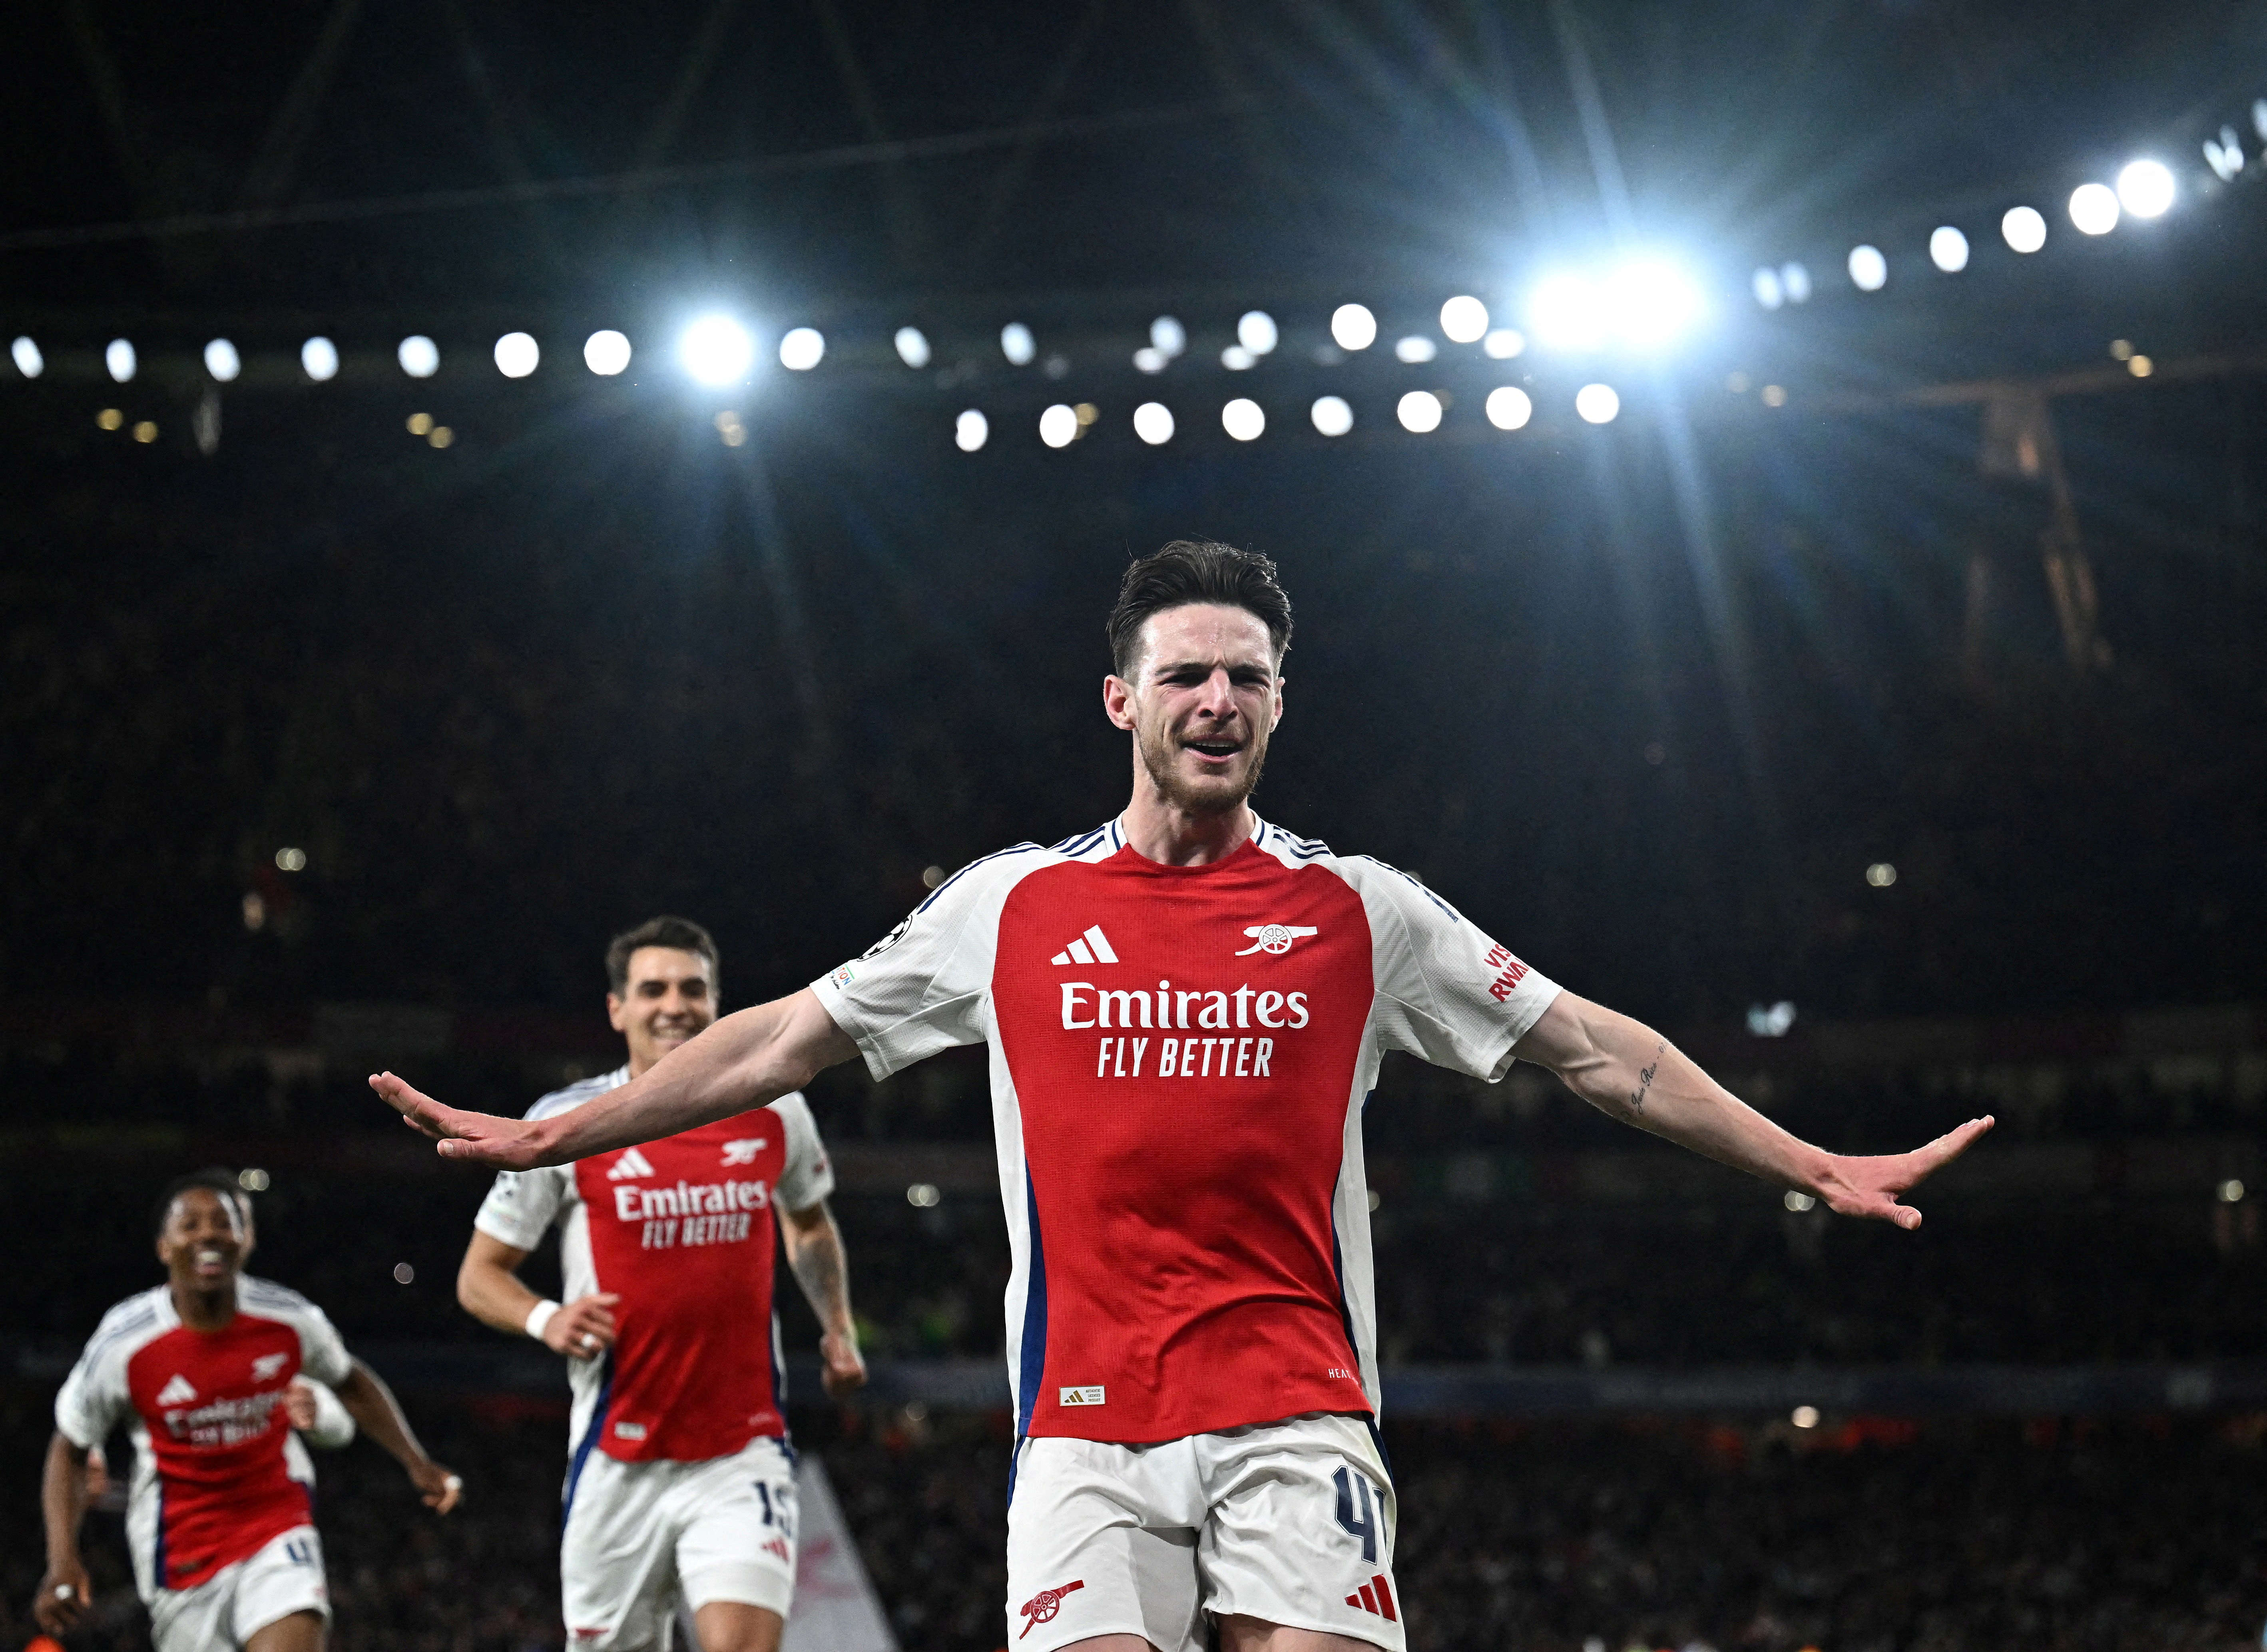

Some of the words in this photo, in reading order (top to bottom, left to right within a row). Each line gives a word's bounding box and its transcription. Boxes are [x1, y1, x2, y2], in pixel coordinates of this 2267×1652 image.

[1488, 957, 1530, 1002] RWA
[1060, 980, 1309, 1030] Emirates
[1097, 1037, 1149, 1077] FLY
[1159, 1037, 1273, 1077] BETTER
[613, 1179, 768, 1222] Emirates
